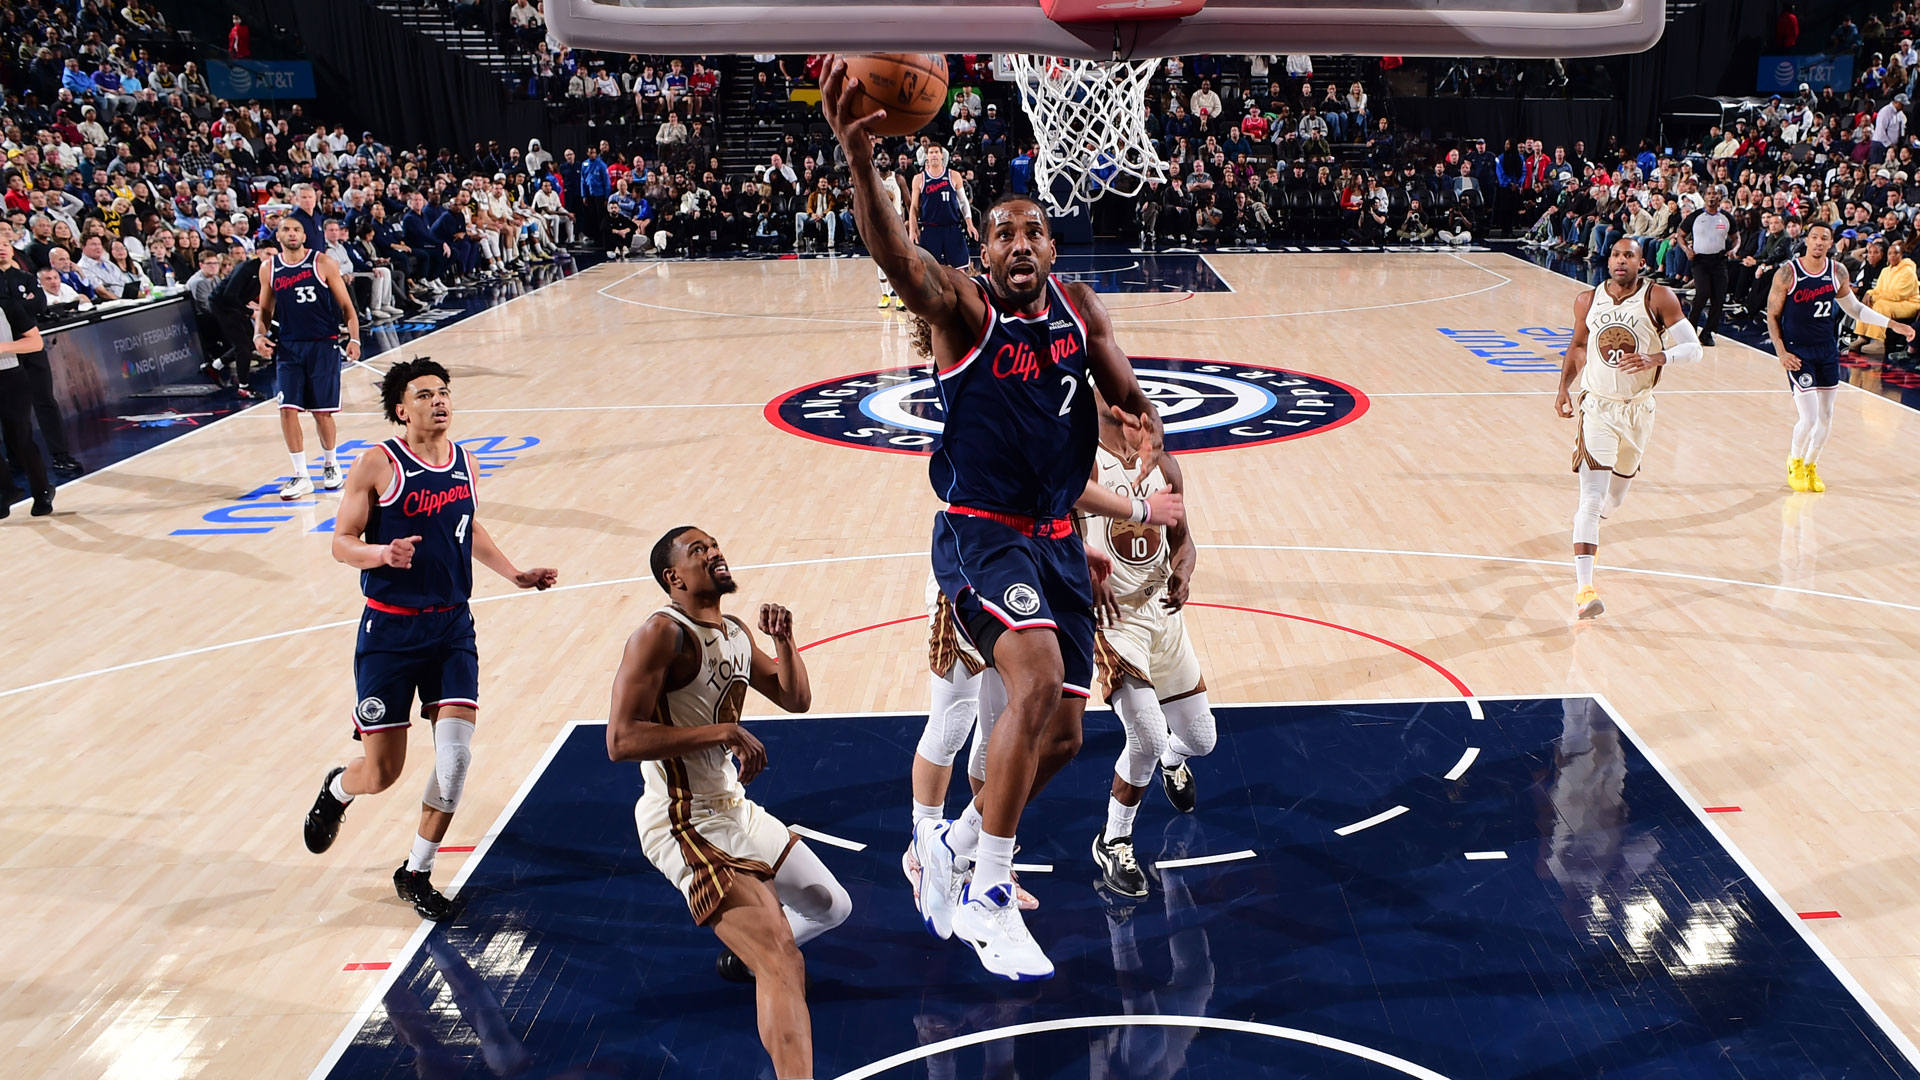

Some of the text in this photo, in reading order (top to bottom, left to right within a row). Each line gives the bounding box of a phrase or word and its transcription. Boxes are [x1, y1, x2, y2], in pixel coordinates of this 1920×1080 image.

[256, 71, 295, 89] AT&T
[941, 191, 950, 202] 11
[274, 270, 312, 291] Clippers
[295, 286, 317, 303] 33
[1793, 284, 1834, 303] Clippers
[1592, 311, 1639, 329] TOWN
[1813, 301, 1832, 318] 22
[113, 323, 189, 354] FRIDAY FEBRUARY 6
[135, 343, 192, 375] NBC peacock
[1058, 375, 1078, 416] 2
[1194, 365, 1335, 437] CLIPPERS
[843, 427, 935, 446] OS
[403, 484, 471, 517] Clippers
[455, 514, 470, 544] 4
[1131, 537, 1148, 559] 10
